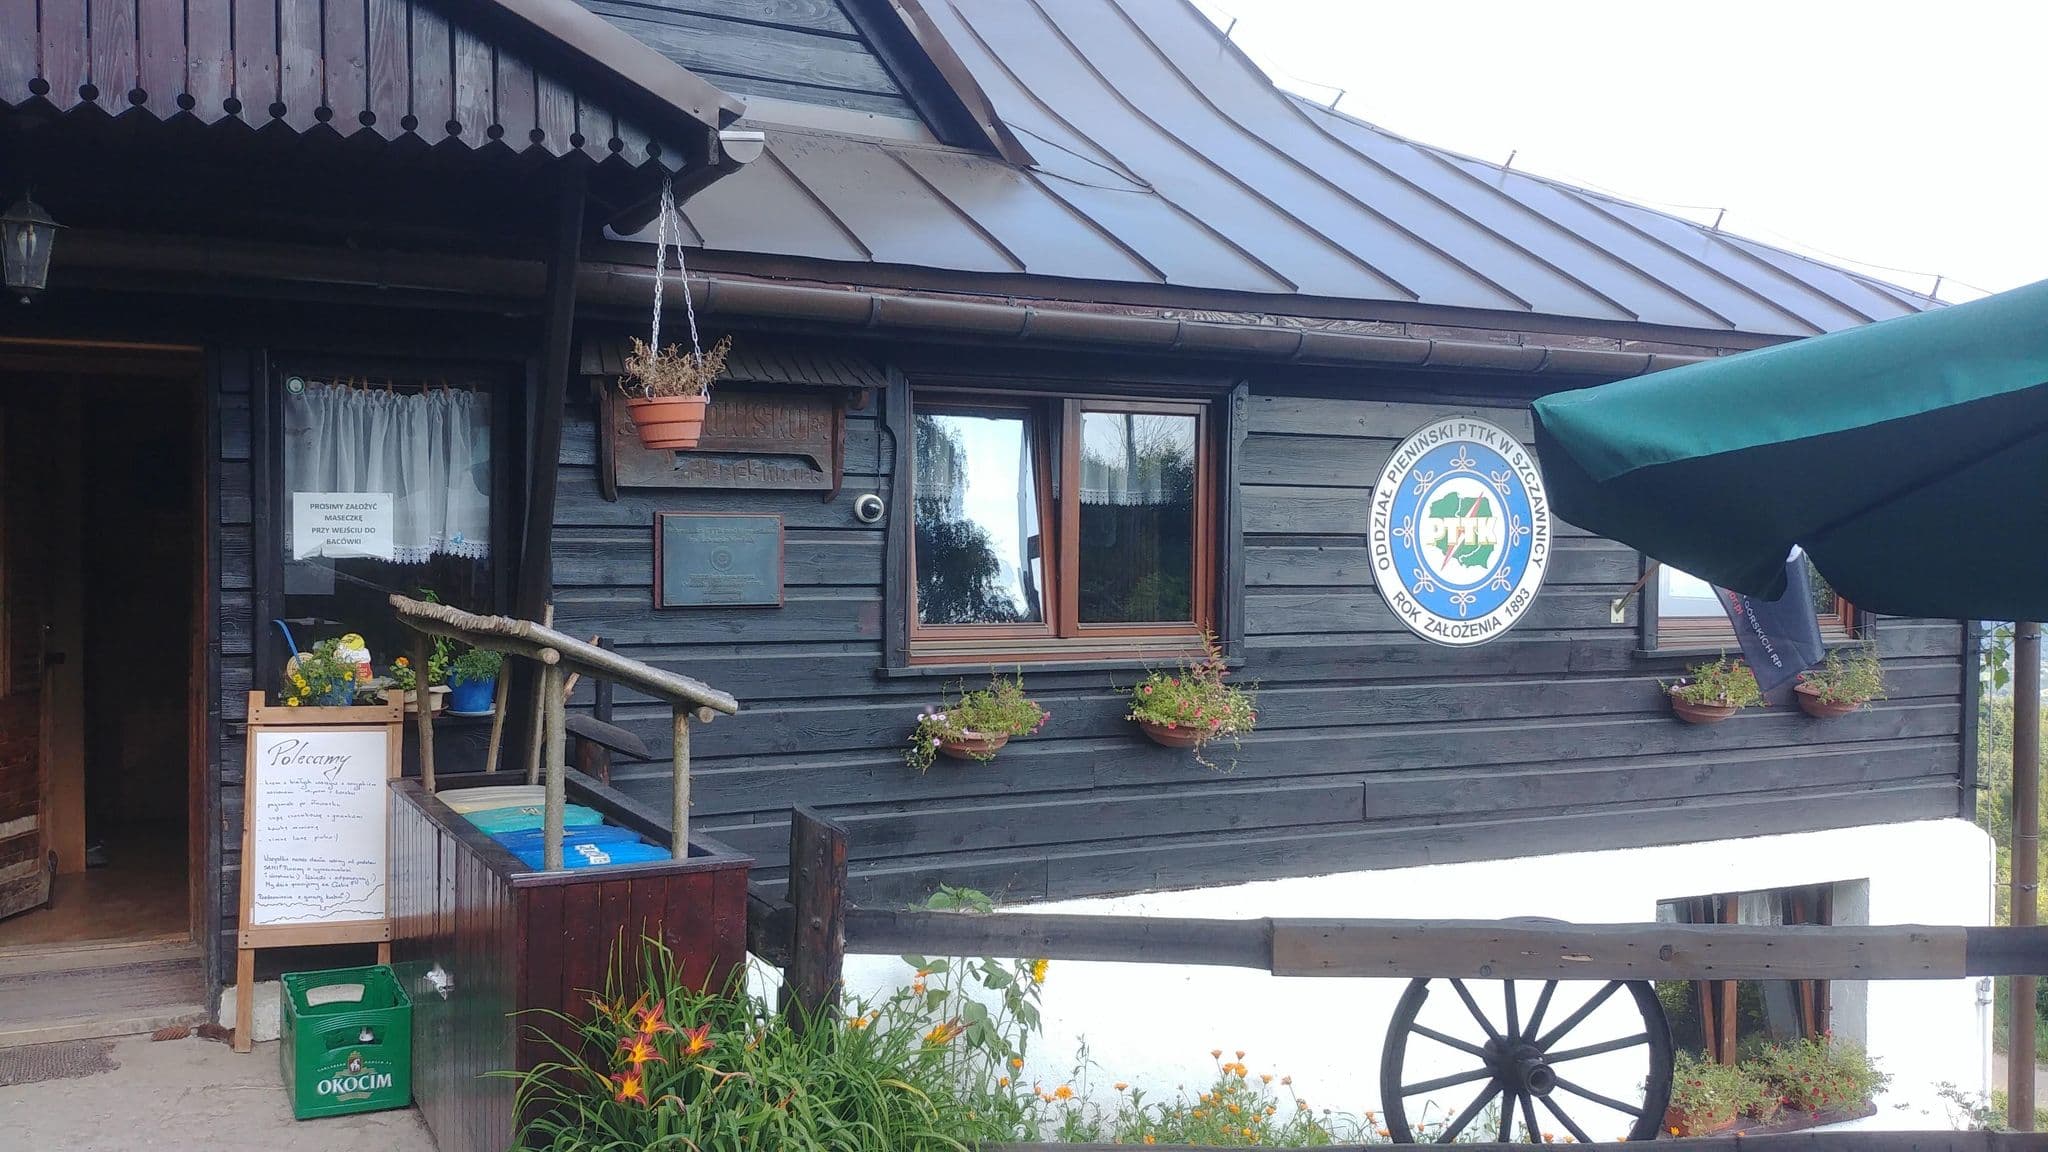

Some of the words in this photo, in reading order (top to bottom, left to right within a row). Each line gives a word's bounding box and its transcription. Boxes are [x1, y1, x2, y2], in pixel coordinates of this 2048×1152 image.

[345, 502, 378, 510] ZAŁOŻYĆ
[1373, 489, 1394, 571] ODDZIAŁ
[1387, 424, 1454, 484] PIENIŃSKI
[1457, 423, 1497, 445] PTTK
[1500, 436, 1513, 455] W
[1512, 452, 1547, 569] SZCZAWNICY
[324, 514, 363, 522] MASECZKĘ
[332, 526, 363, 534] WEJŚCIU
[1426, 516, 1498, 546] PTTK
[326, 537, 362, 545] BACÓWKI
[1392, 590, 1422, 624] ROK
[1423, 615, 1503, 639] ZAŁOŻENIA
[1504, 587, 1531, 619] 1893
[1744, 600, 1774, 655] GÓRSKICH
[1770, 653, 1783, 669] RP
[267, 738, 352, 781] Polecamy
[317, 1073, 393, 1096] OKOCIM
